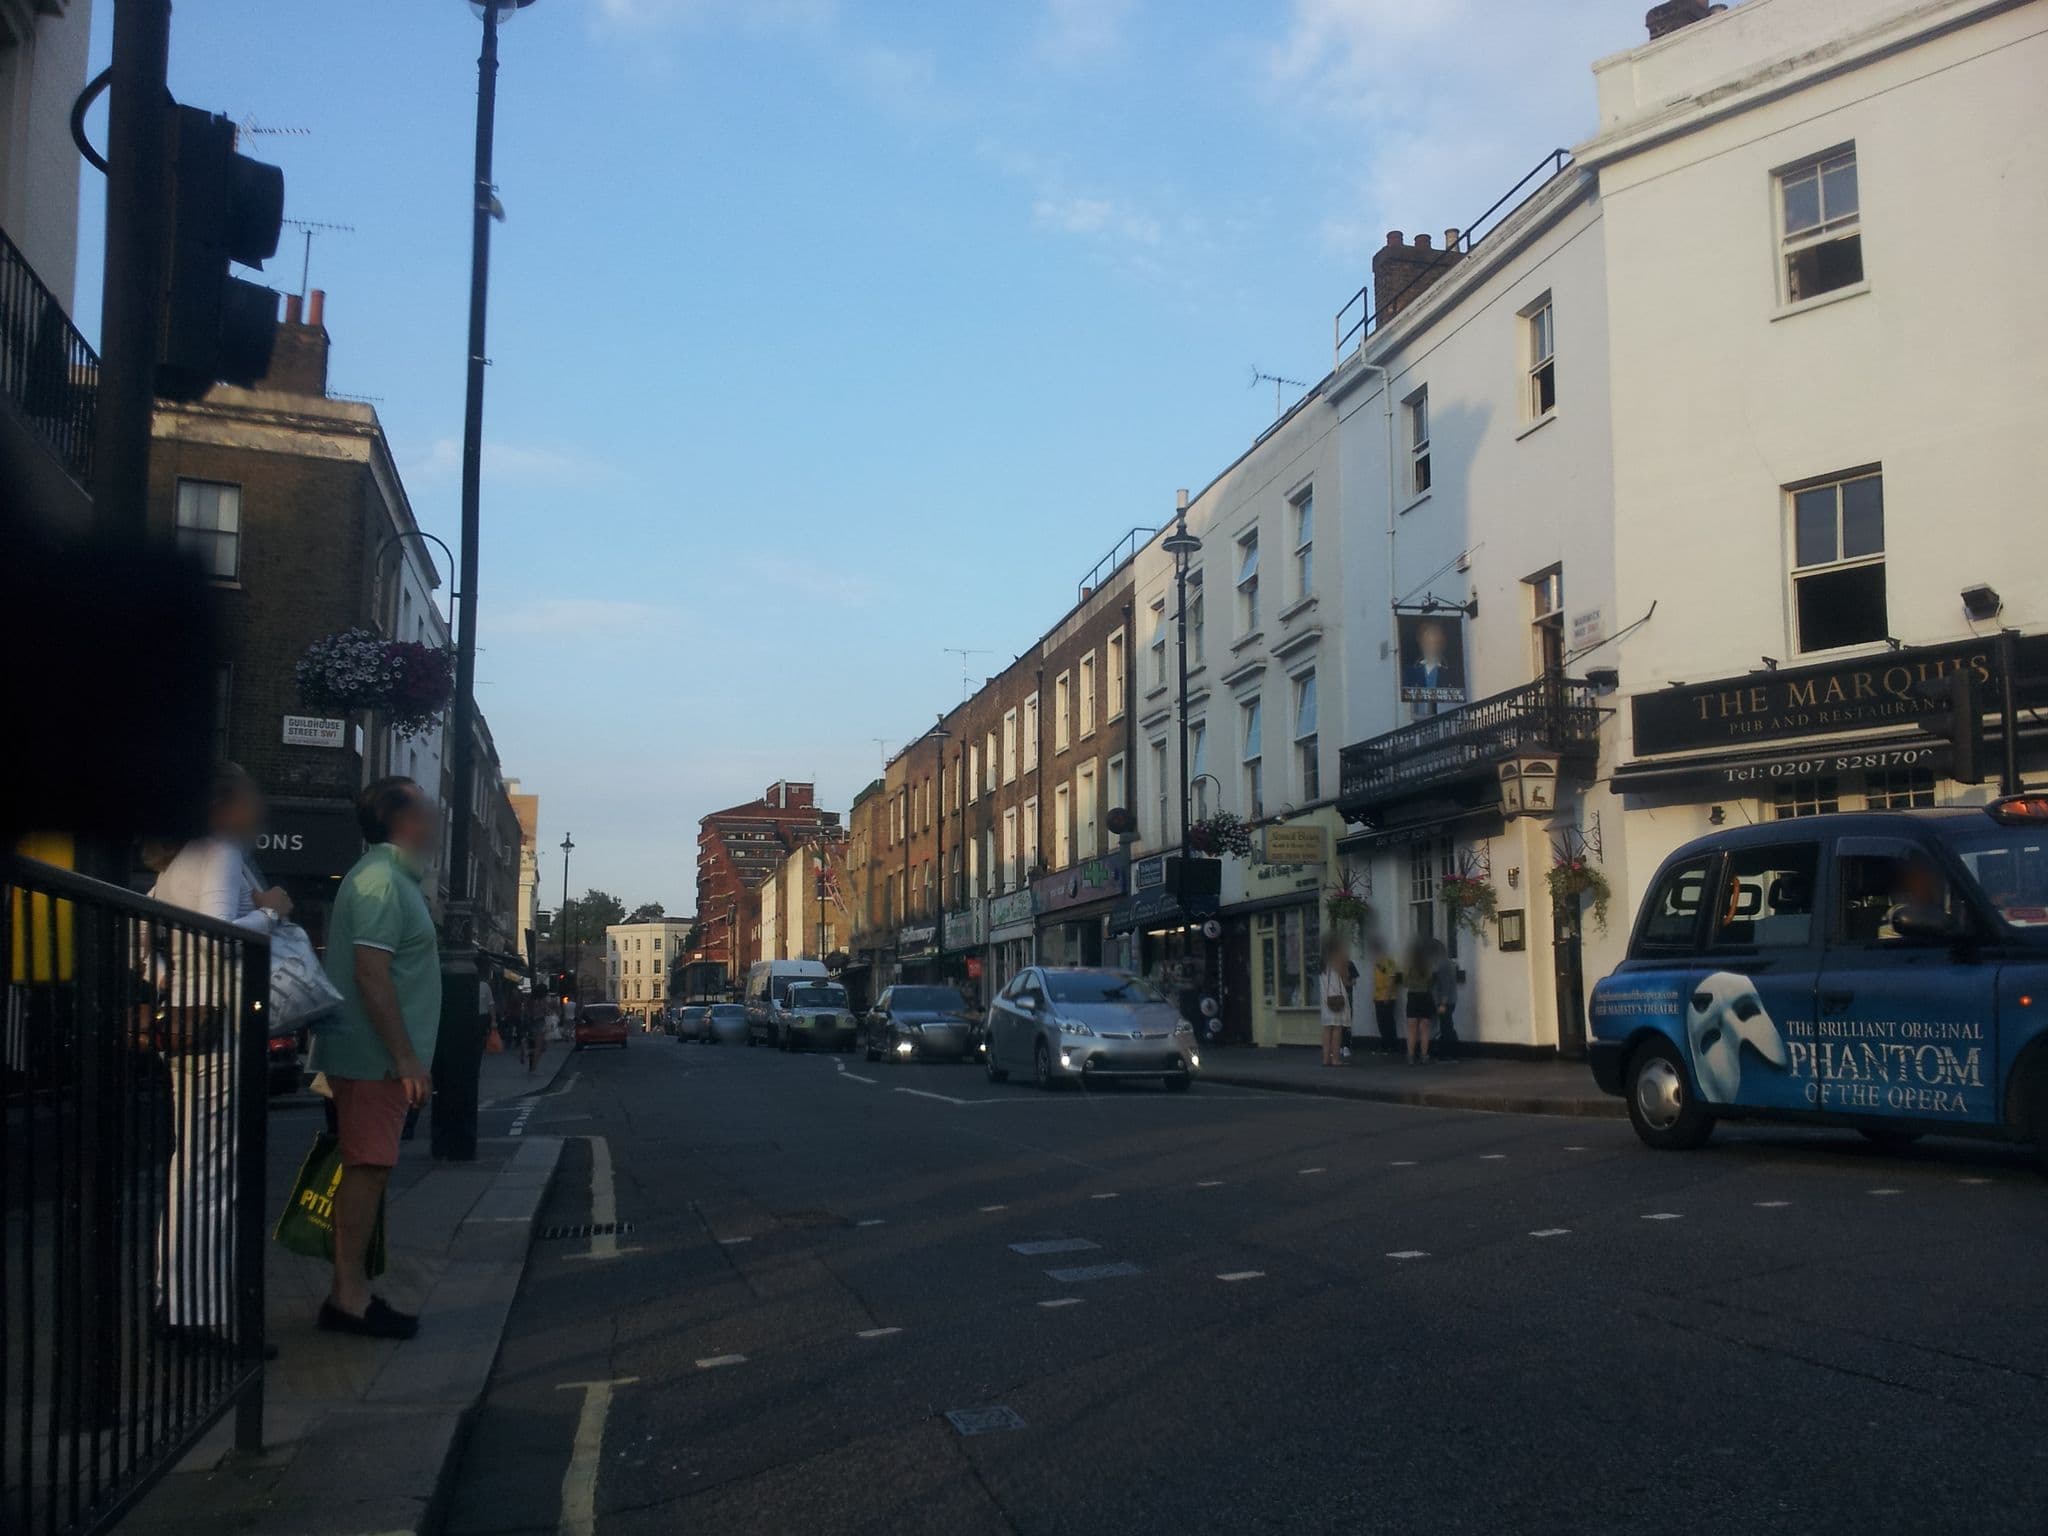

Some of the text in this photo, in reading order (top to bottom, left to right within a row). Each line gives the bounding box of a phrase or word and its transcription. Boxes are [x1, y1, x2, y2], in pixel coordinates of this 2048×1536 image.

[1692, 687, 1769, 720] THE
[1729, 698, 1948, 735] PUB AND RESTAURAN
[288, 727, 337, 738] STREET SW1
[1723, 767, 1765, 783] Tel:
[1769, 760, 1826, 778] 0207
[1643, 1003, 1680, 1015] THEATRE
[1786, 1021, 1984, 1039] THE BRILLIANT ORIGINAL
[1786, 1041, 1985, 1087] PHANTOM
[1805, 1082, 1969, 1113] OF THE OPERA
